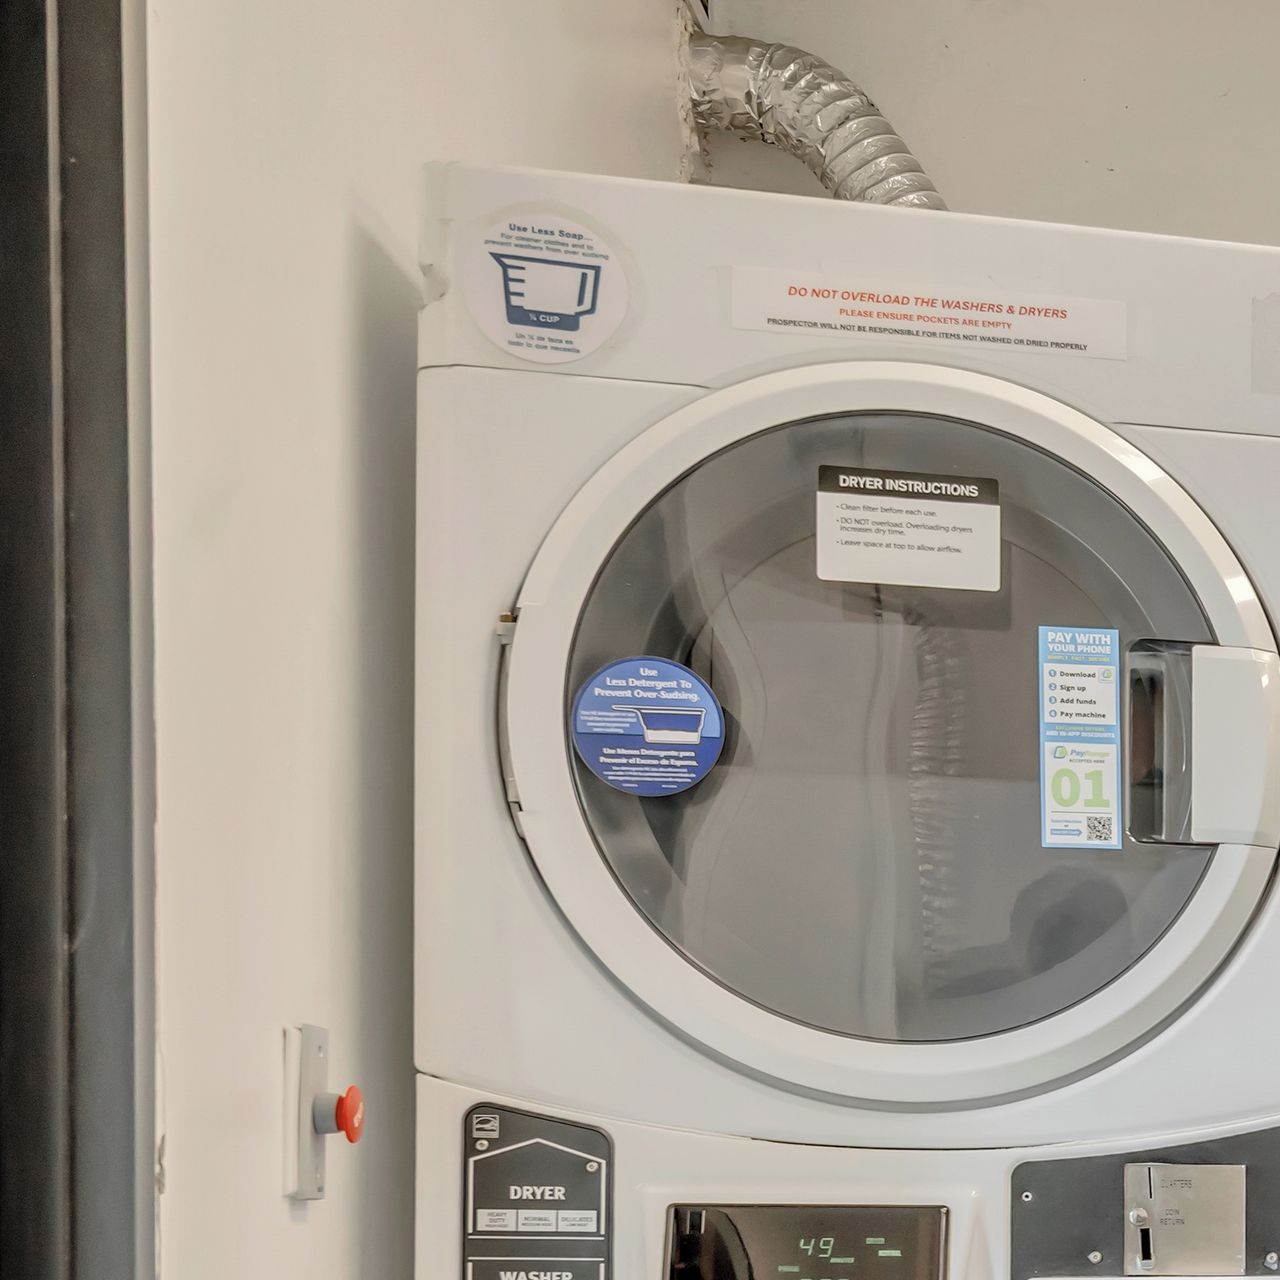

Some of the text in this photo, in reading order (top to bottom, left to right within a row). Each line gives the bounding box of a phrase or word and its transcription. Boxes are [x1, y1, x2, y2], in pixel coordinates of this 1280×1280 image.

[788, 286, 1067, 319] DO NOT OVERLOAD THE WASHERS & DRYERS
[839, 475, 979, 497] DRYER INSTRUCTIONS
[1051, 768, 1110, 808] 01
[509, 1185, 566, 1200] DRYER
[800, 1237, 834, 1257] 49
